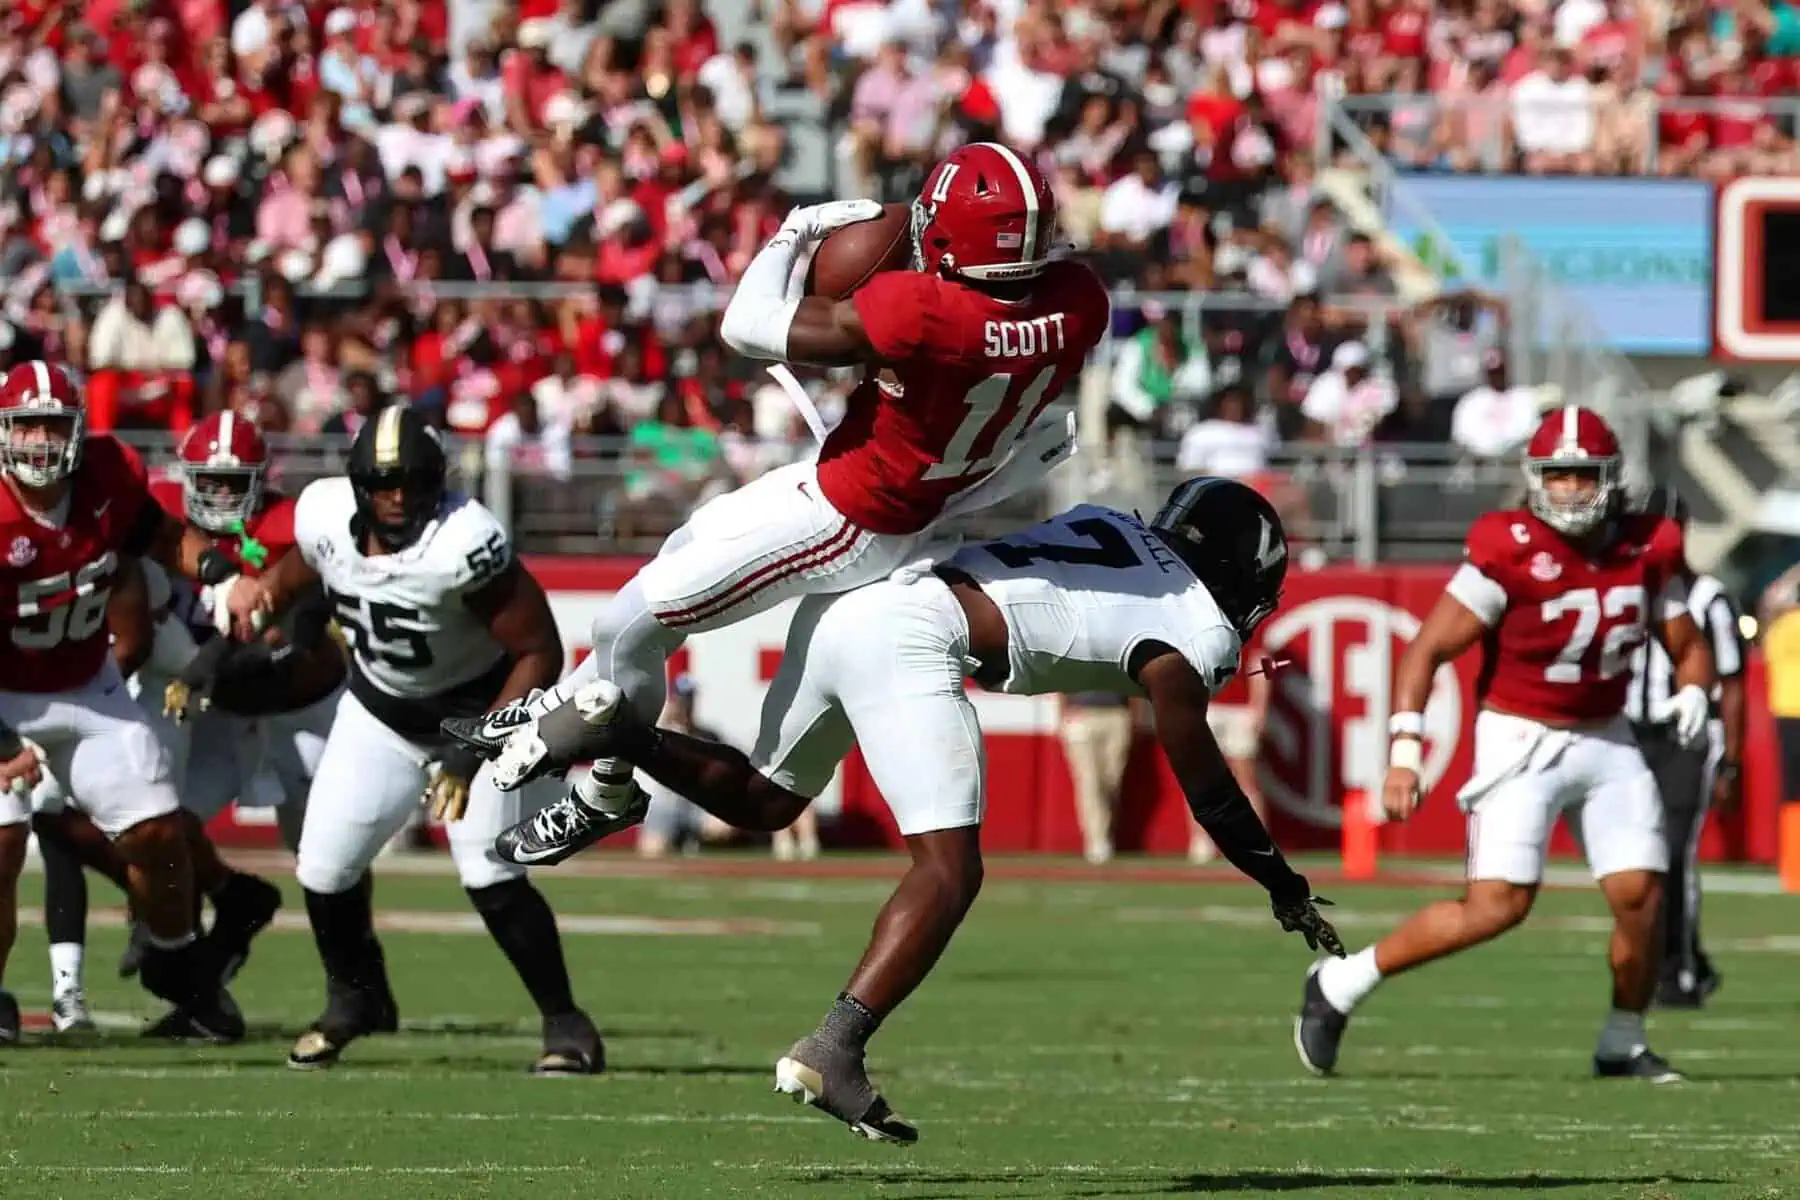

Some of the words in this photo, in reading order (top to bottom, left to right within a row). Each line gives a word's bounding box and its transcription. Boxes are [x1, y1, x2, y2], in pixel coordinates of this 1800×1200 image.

[984, 312, 1065, 357] SCOTT
[920, 363, 1057, 481] 11
[466, 531, 510, 576] 55
[984, 517, 1144, 568] 7
[11, 551, 118, 649] 56
[328, 583, 433, 666] 55
[1541, 583, 1648, 684] 72
